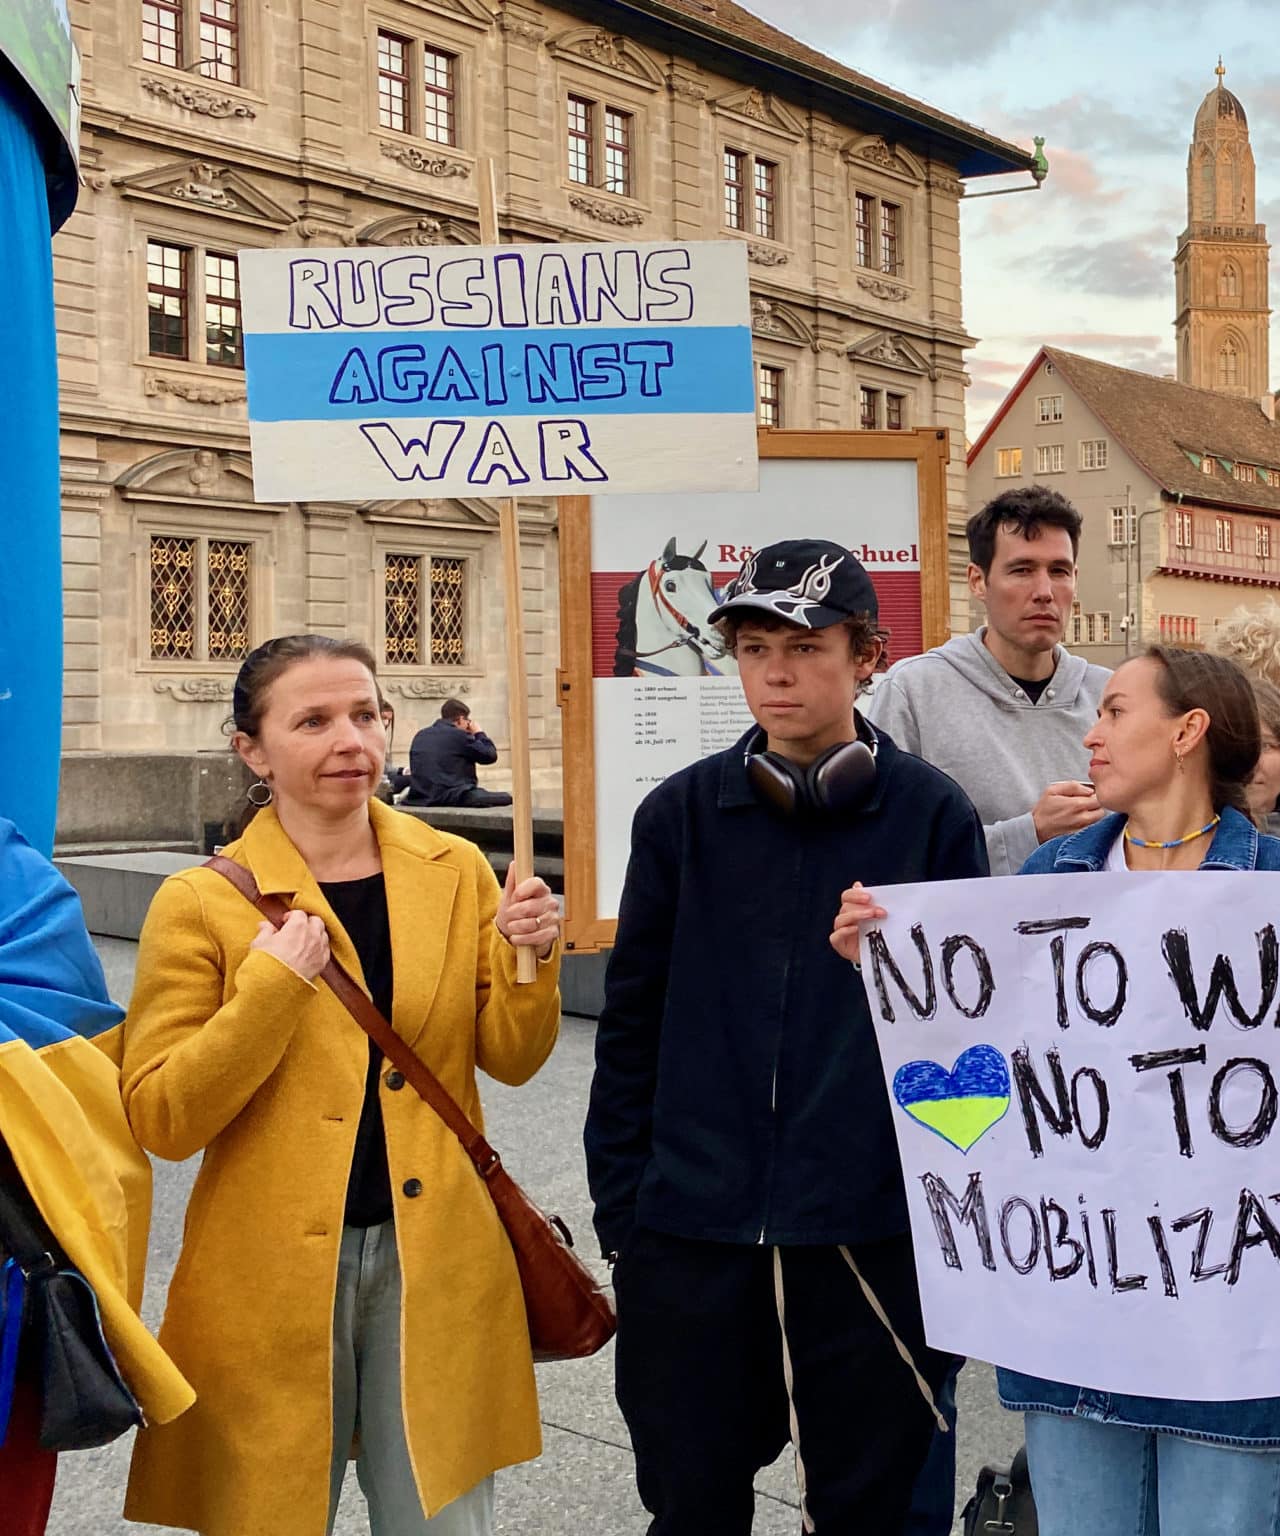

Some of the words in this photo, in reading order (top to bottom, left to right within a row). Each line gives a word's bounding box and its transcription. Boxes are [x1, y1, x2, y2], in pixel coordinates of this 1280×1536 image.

[289, 249, 695, 329] RUSSIANS
[329, 341, 674, 406] AGAINST
[360, 419, 609, 485] WAR
[865, 922, 996, 1024] NO
[1013, 917, 1129, 1030] TO
[1011, 1044, 1110, 1159] NO
[1128, 1044, 1279, 1159] TO
